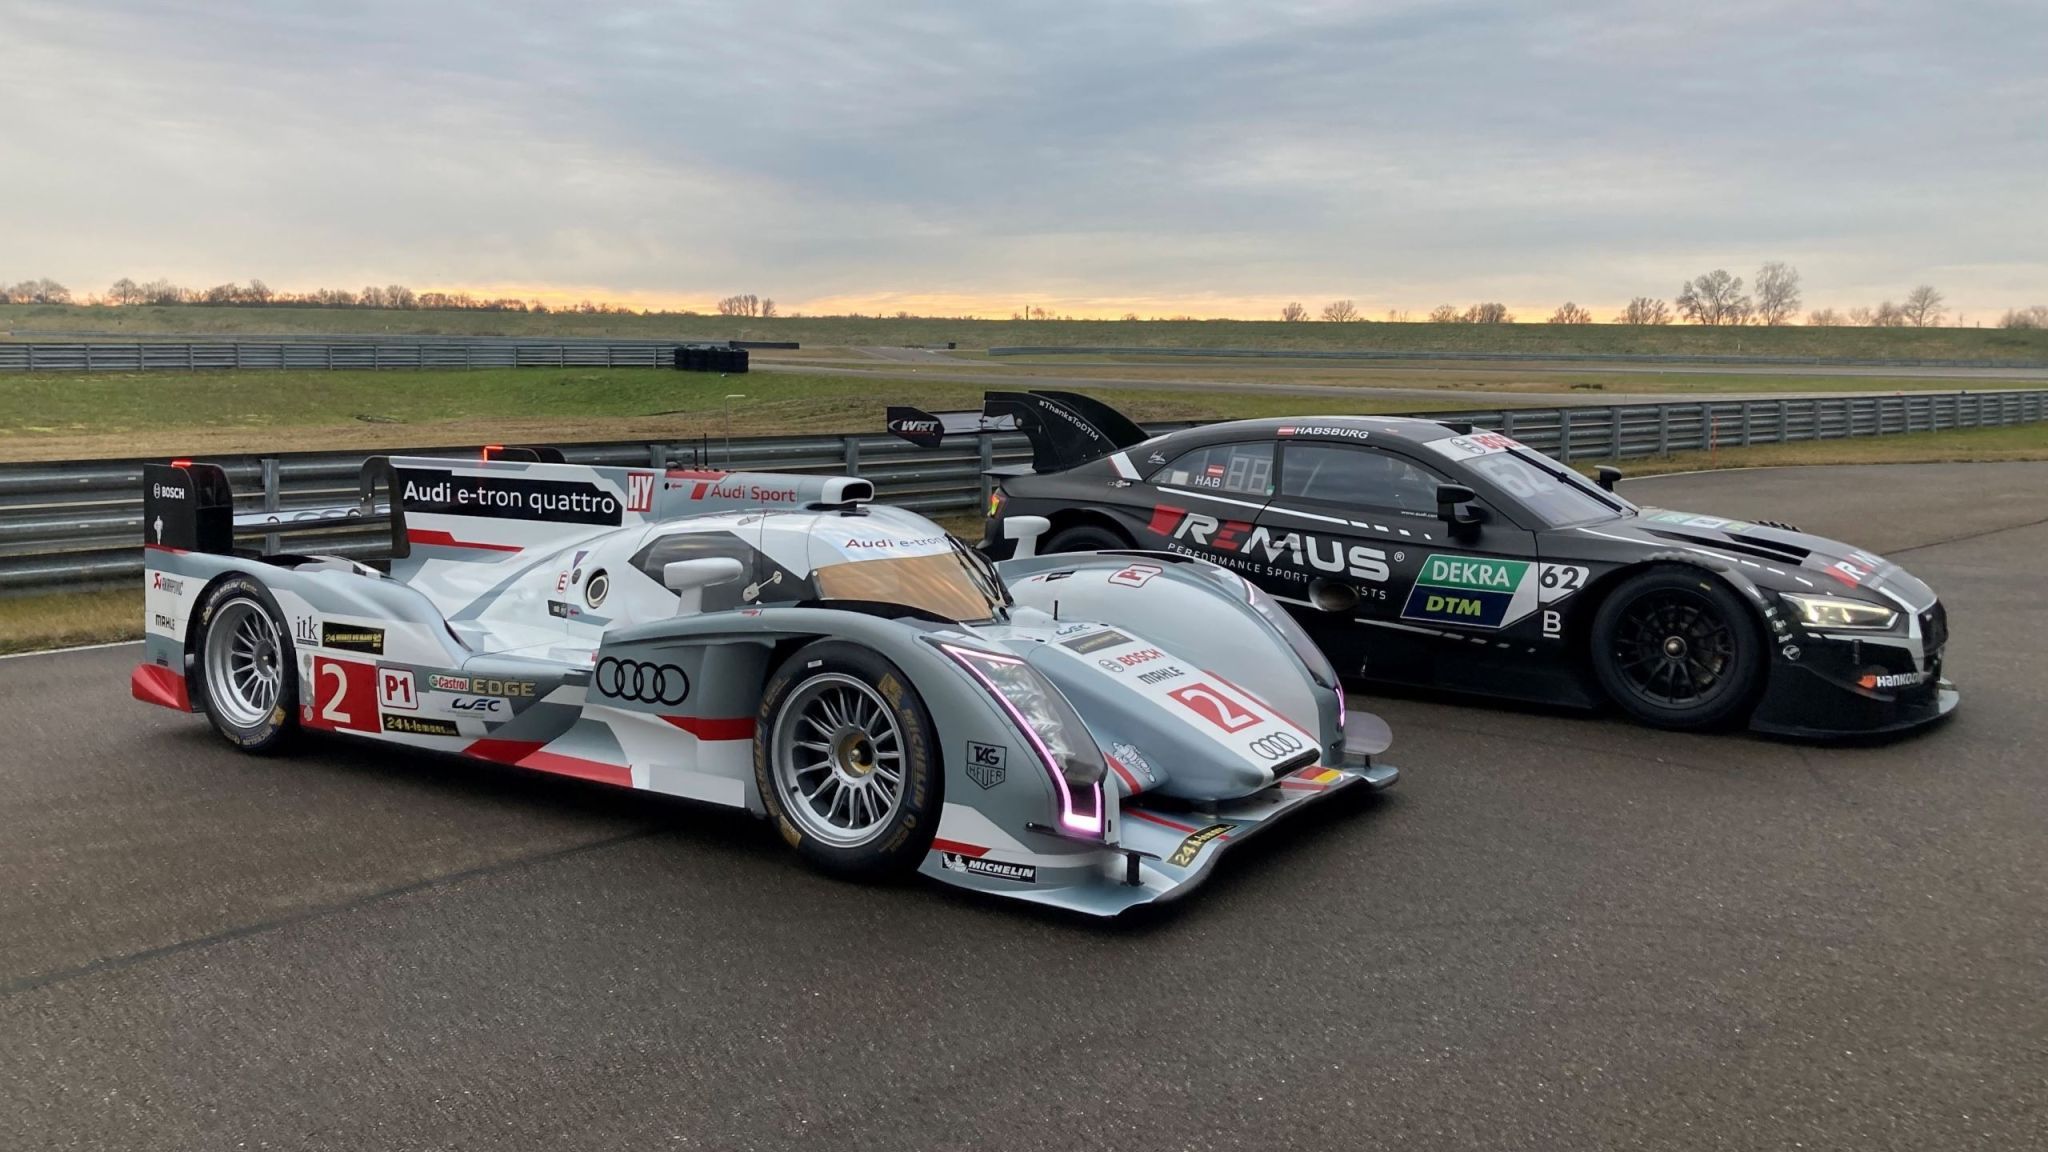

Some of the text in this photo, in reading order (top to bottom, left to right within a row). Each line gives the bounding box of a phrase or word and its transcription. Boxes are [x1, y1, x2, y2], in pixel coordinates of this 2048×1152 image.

[901, 420, 939, 432] WRT
[1039, 400, 1099, 441] #ThanksToDTM
[1295, 427, 1369, 439] HABSBURG
[1194, 475, 1221, 487] HAB
[162, 486, 185, 499] BOSCH
[403, 481, 615, 513] Audi e-tron quattro
[627, 475, 653, 509] HY
[710, 485, 796, 504] Audi Sport
[845, 539, 894, 548] Audi
[1173, 512, 1390, 582] REMUS
[1432, 560, 1510, 587] DEKRA
[1540, 566, 1580, 590] 62
[1426, 596, 1481, 616] DTM
[155, 614, 176, 631] MAHLE
[296, 615, 319, 640] itk
[1543, 610, 1561, 632] B
[1117, 649, 1165, 666] BOSCH
[1138, 666, 1185, 685] MAHLE
[1876, 672, 1921, 687] Hankoo
[322, 663, 351, 723] 2
[385, 675, 410, 703] P1
[439, 677, 536, 697] Castrol EDGE
[1181, 689, 1254, 728] 2
[973, 746, 1000, 765] TAG
[968, 766, 1003, 787] HEUER
[968, 860, 1034, 878] MICHELIN
